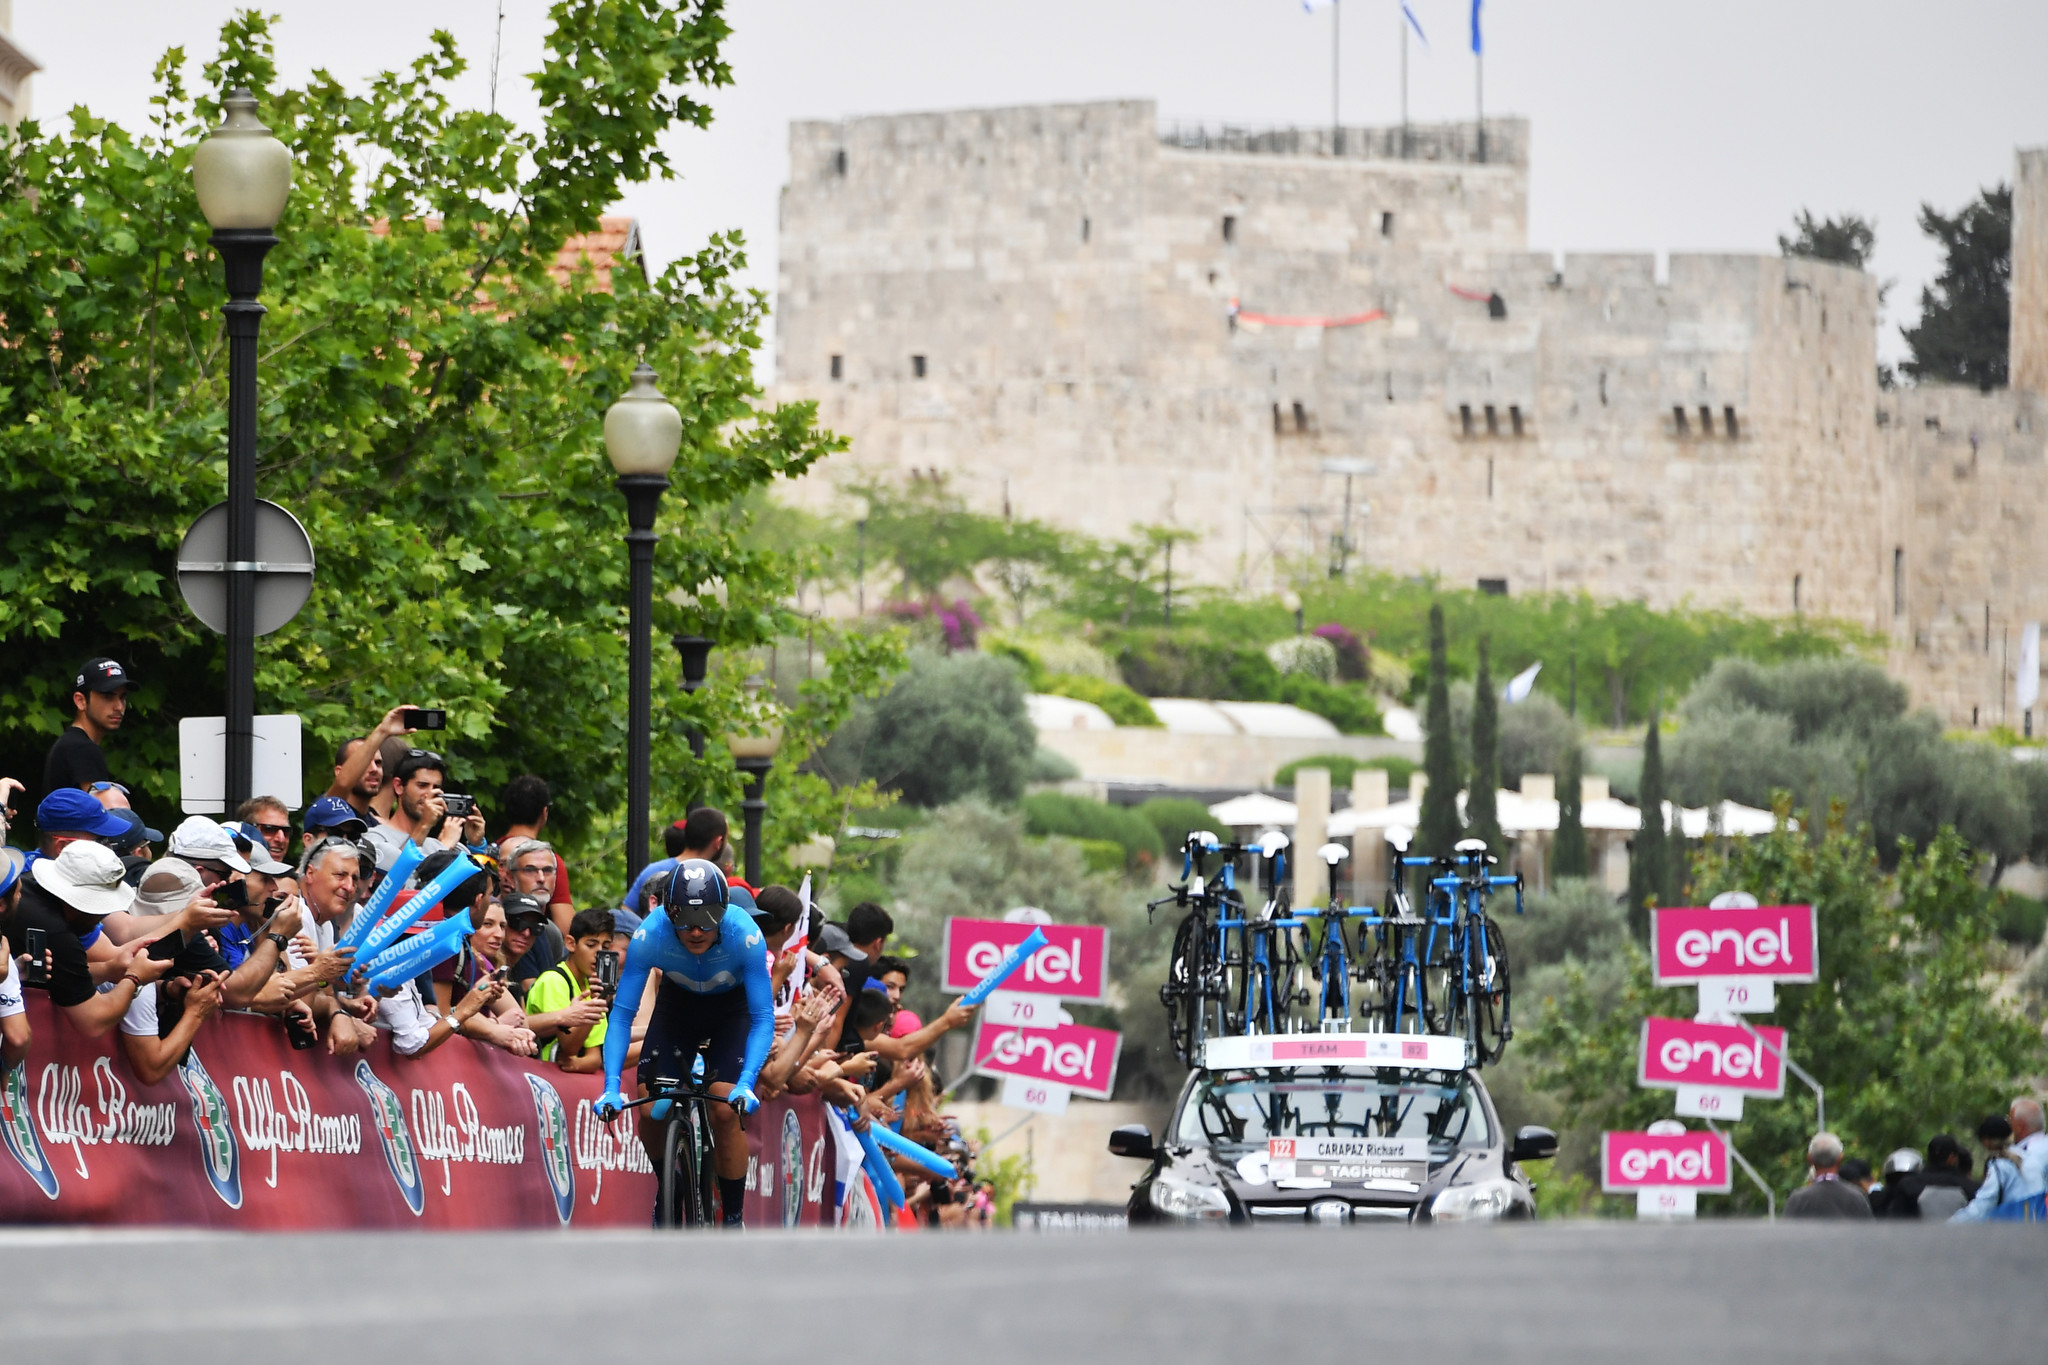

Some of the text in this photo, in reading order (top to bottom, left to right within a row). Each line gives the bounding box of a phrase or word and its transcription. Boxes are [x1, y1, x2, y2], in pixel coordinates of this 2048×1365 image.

[343, 875, 393, 945] SHIMANO
[366, 880, 442, 947] SHIMANO
[1675, 917, 1793, 967] enel
[1011, 1002, 1034, 1019] 70
[1725, 986, 1748, 1004] 70
[992, 1031, 1096, 1080] enel
[1301, 1044, 1338, 1055] TEAM
[1660, 1034, 1763, 1079] enel
[38, 1062, 100, 1180] Alfa
[93, 1056, 177, 1146] Romeo
[1025, 1087, 1047, 1104] 60
[233, 1075, 299, 1188] Alfa
[280, 1070, 361, 1155] Romeo
[411, 1088, 464, 1197] Alfa
[452, 1082, 524, 1164] Romeo
[1273, 1140, 1405, 1158] 122 CARAPAZ Richard
[1620, 1141, 1713, 1180] enel
